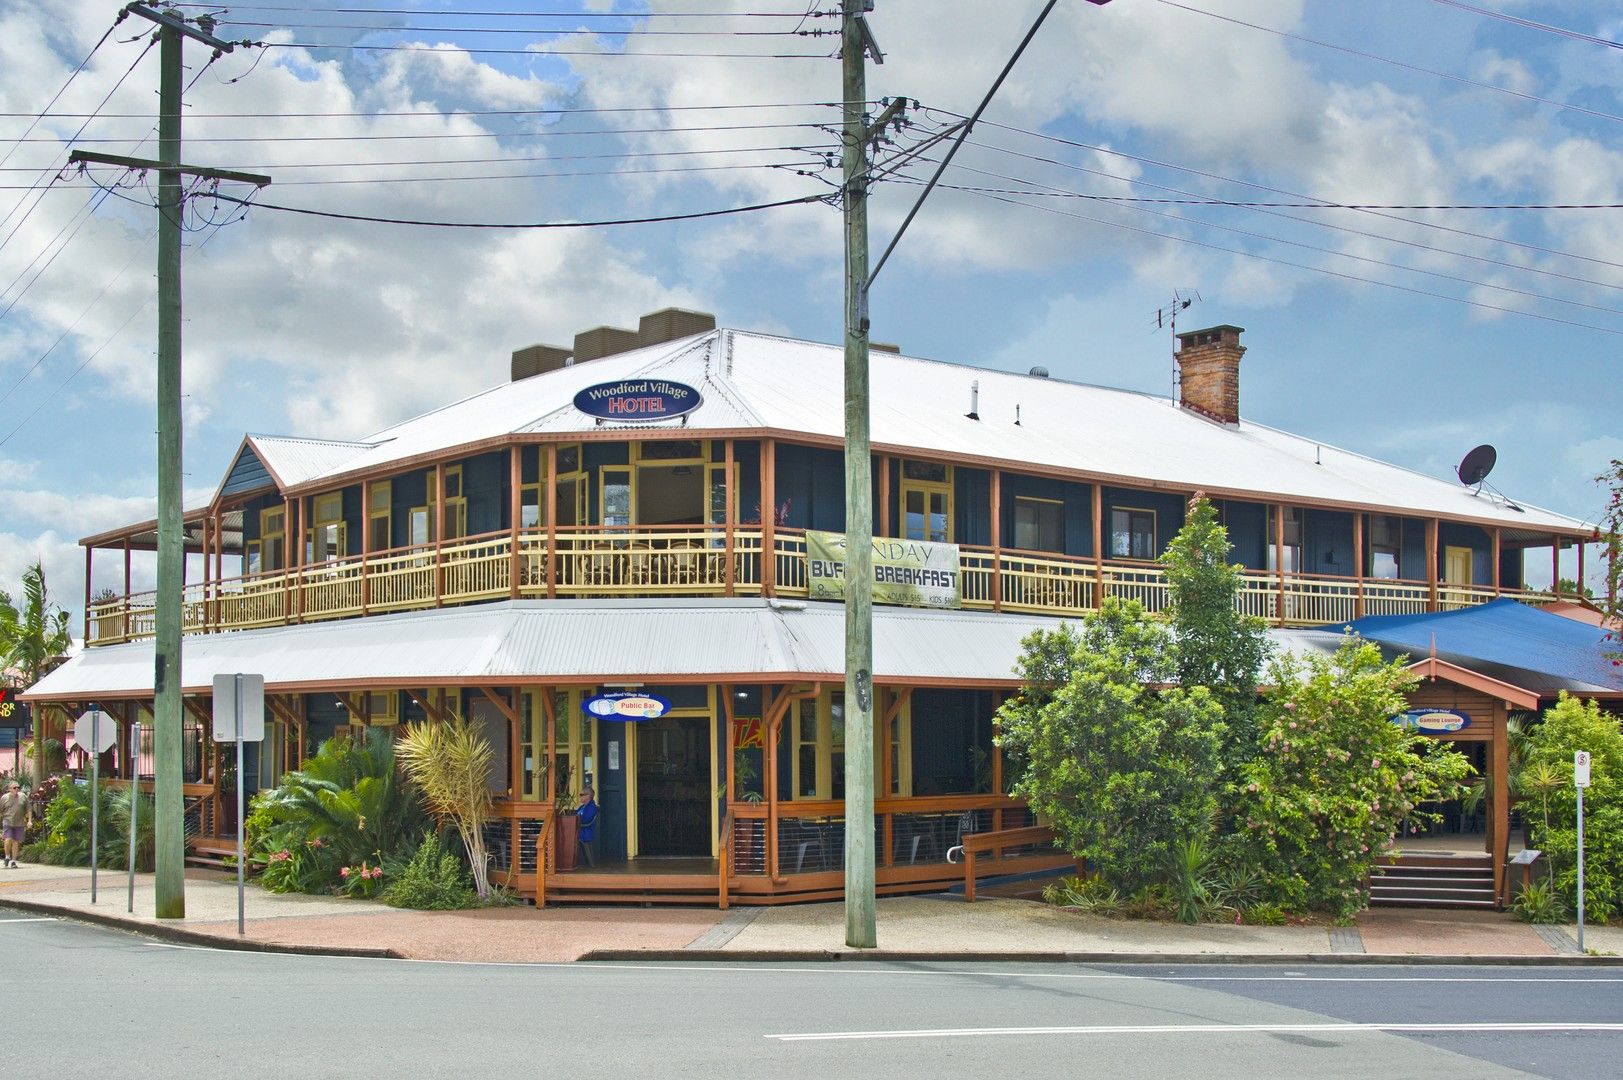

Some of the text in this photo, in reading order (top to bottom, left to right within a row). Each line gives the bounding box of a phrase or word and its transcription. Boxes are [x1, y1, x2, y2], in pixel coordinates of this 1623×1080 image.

[589, 382, 688, 400] Woodford Village
[609, 397, 666, 413] HOTEL
[811, 560, 957, 588] BUF BREAKFAST
[930, 595, 941, 604] KIDS
[0, 702, 15, 710] OR
